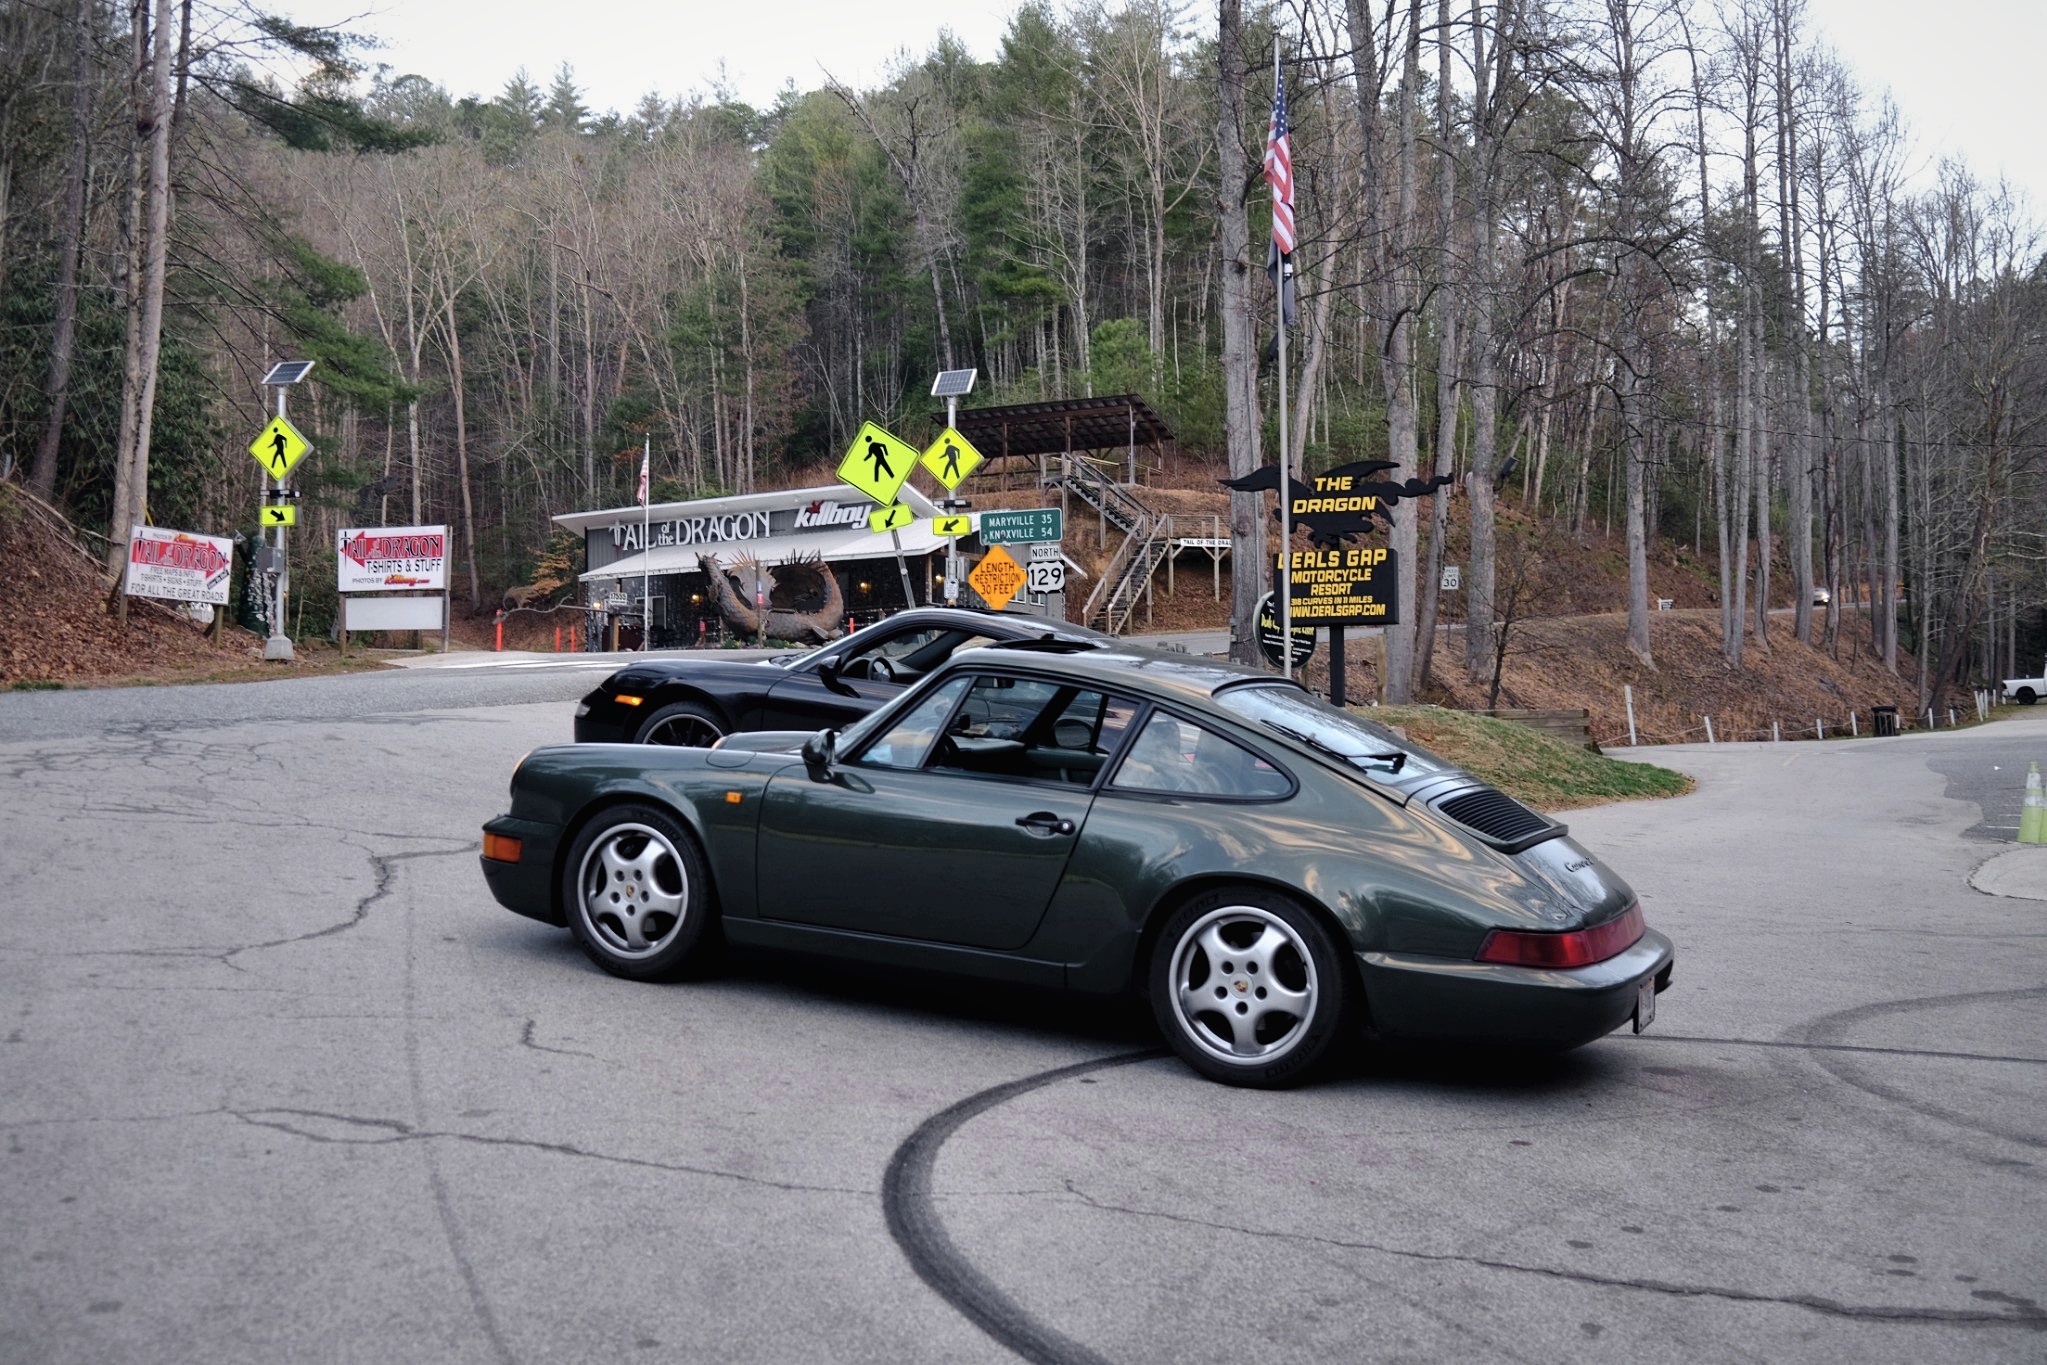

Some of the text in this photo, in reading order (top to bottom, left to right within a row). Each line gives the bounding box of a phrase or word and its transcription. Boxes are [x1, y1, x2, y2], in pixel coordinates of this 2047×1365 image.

[1315, 476, 1353, 491] THE
[1293, 496, 1376, 514] DRAGON
[661, 521, 671, 533] of
[989, 514, 1053, 527] MARYVILLE 35
[676, 511, 770, 545] DRAGON
[989, 527, 1053, 540] KNOXVILLE 54
[658, 533, 674, 546] the
[382, 535, 441, 558] DRAGON
[1032, 547, 1059, 558] NORTH
[1347, 549, 1387, 567] GAP
[405, 560, 412, 572] &
[415, 558, 442, 572] STUFF
[980, 562, 1015, 573] LENGTH
[974, 573, 1020, 585] RESTRICTION
[1030, 567, 1061, 586] 129
[1291, 568, 1372, 584] MOTORCYCLE
[981, 583, 1015, 595] 30 FEET
[1311, 583, 1353, 596] RESORT
[1444, 578, 1457, 588] 30
[131, 582, 225, 602] FOR ALL THE GREAT ROADS
[1302, 596, 1333, 605] CURVES
[1334, 596, 1342, 604] IN
[1343, 596, 1348, 604] 11
[1349, 595, 1373, 603] MILES
[1289, 604, 1386, 618] WW.DEALSGAP.COM
